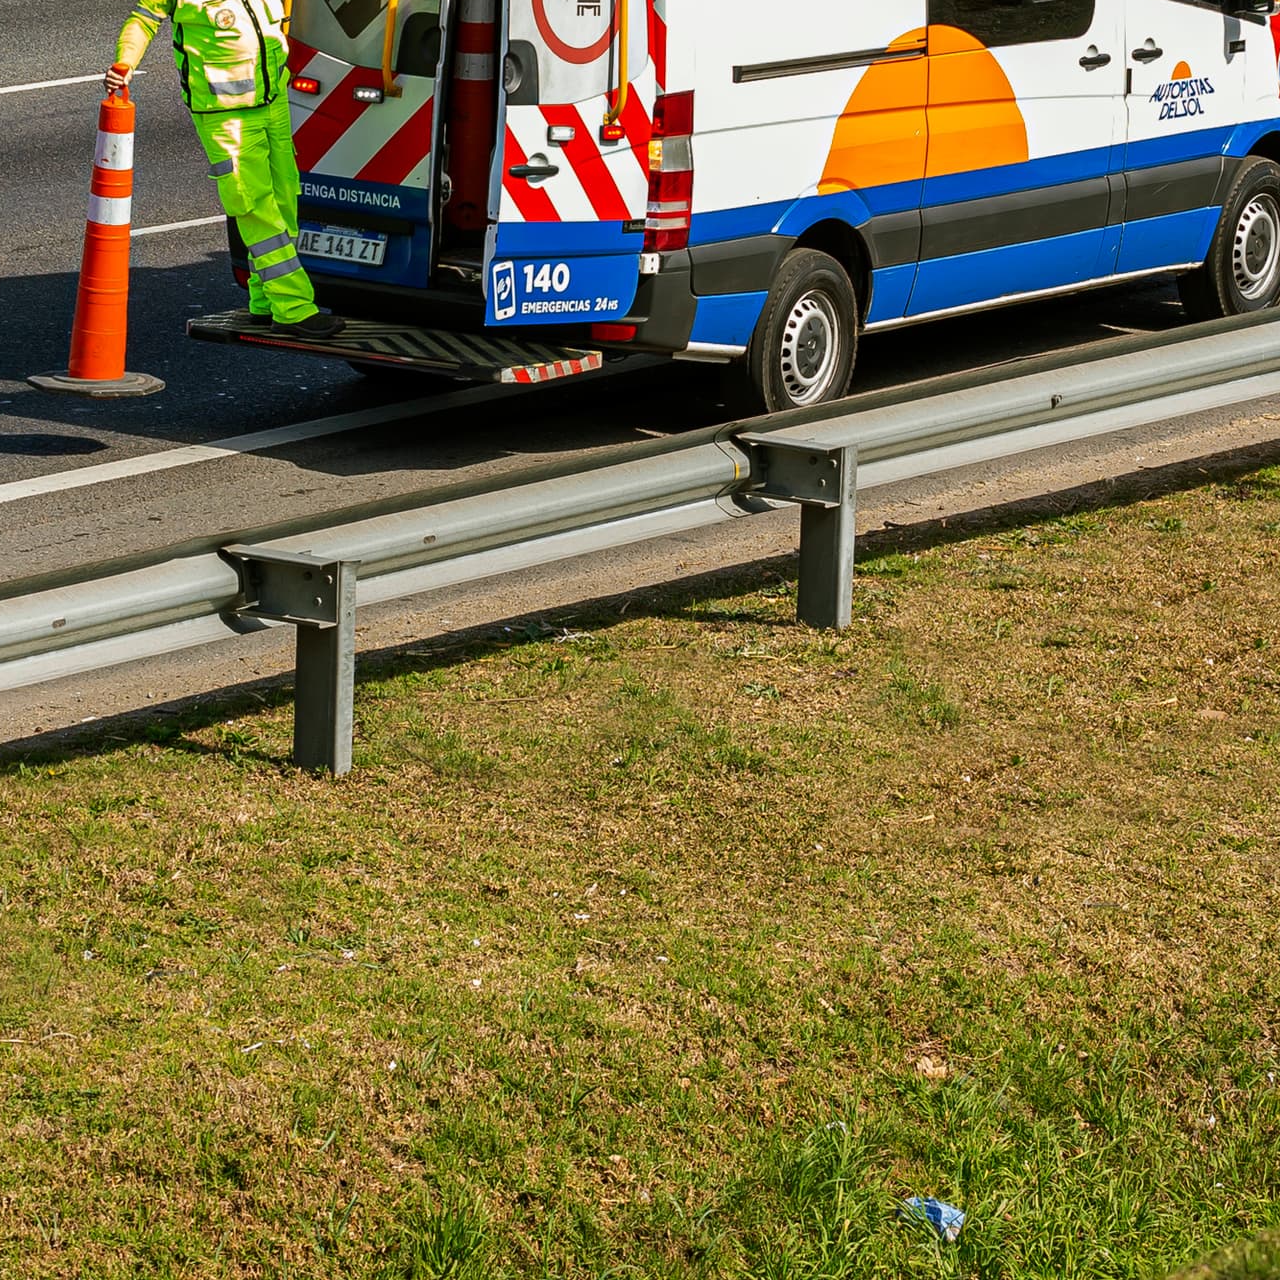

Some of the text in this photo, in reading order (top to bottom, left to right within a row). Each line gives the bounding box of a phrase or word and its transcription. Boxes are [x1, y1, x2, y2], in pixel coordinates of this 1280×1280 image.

[1149, 77, 1215, 103] AUTOPISTAS
[339, 187, 401, 209] DISTANCIA
[300, 231, 321, 252] AE
[324, 236, 355, 258] 141
[358, 240, 380, 261] ZT
[523, 262, 570, 294] 140
[521, 299, 591, 314] EMERGENCIAS
